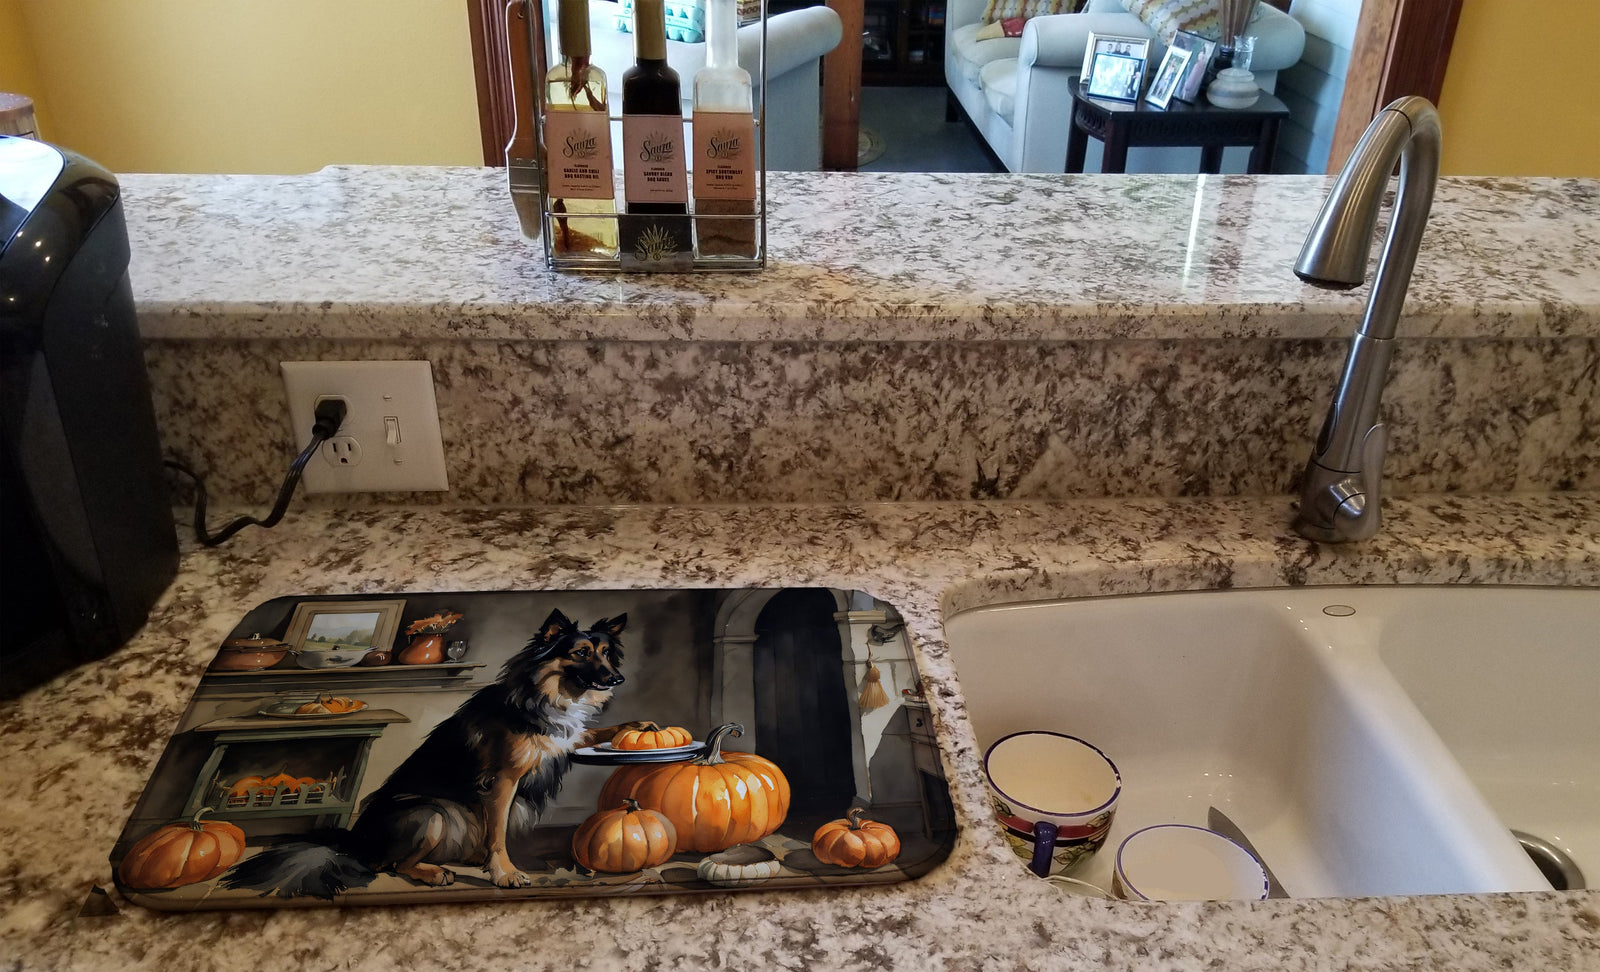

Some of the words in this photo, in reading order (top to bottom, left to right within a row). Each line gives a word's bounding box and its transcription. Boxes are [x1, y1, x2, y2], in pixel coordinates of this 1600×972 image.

[562, 136, 597, 158] Sauza
[640, 139, 674, 162] Sauza
[706, 136, 741, 158] Sauza
